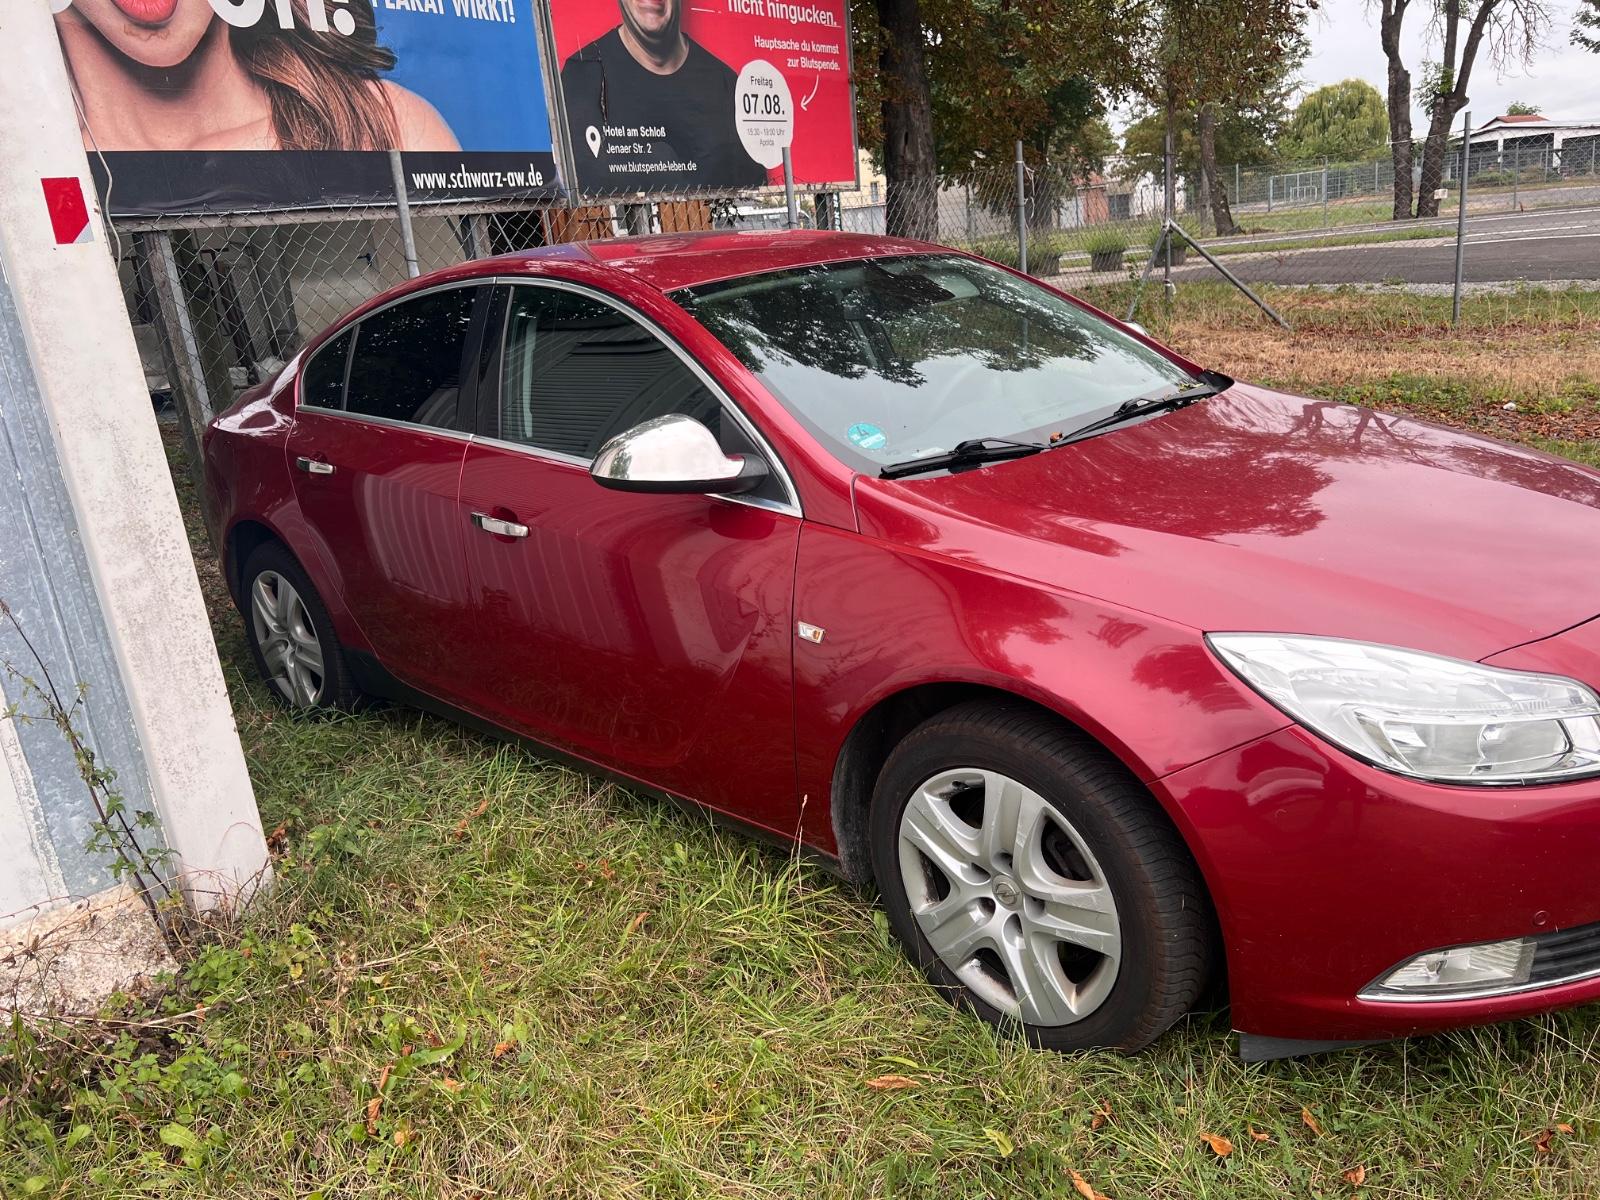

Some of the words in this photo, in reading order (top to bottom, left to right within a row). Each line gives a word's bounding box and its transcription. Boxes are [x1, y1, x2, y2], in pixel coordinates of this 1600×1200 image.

[452, 0, 516, 23] WIRKT!
[728, 0, 765, 16] nicht
[767, 0, 837, 26] hingucken.
[754, 35, 800, 51] Hauptsache
[801, 40, 811, 52] du
[811, 41, 839, 54] kommst
[787, 58, 799, 68] zur
[800, 57, 840, 71] Blutspende.
[751, 76, 773, 88] Freitag
[743, 93, 785, 115] 07.08.
[603, 126, 625, 137] Hotel
[626, 128, 639, 137] am
[640, 126, 666, 137] Schloß
[606, 143, 632, 154] Jenaer
[633, 143, 645, 154] Str.
[646, 143, 652, 154] 2
[608, 160, 697, 174] www.blutspende-leben.de
[412, 163, 543, 189] www.schwarz-aw.de
